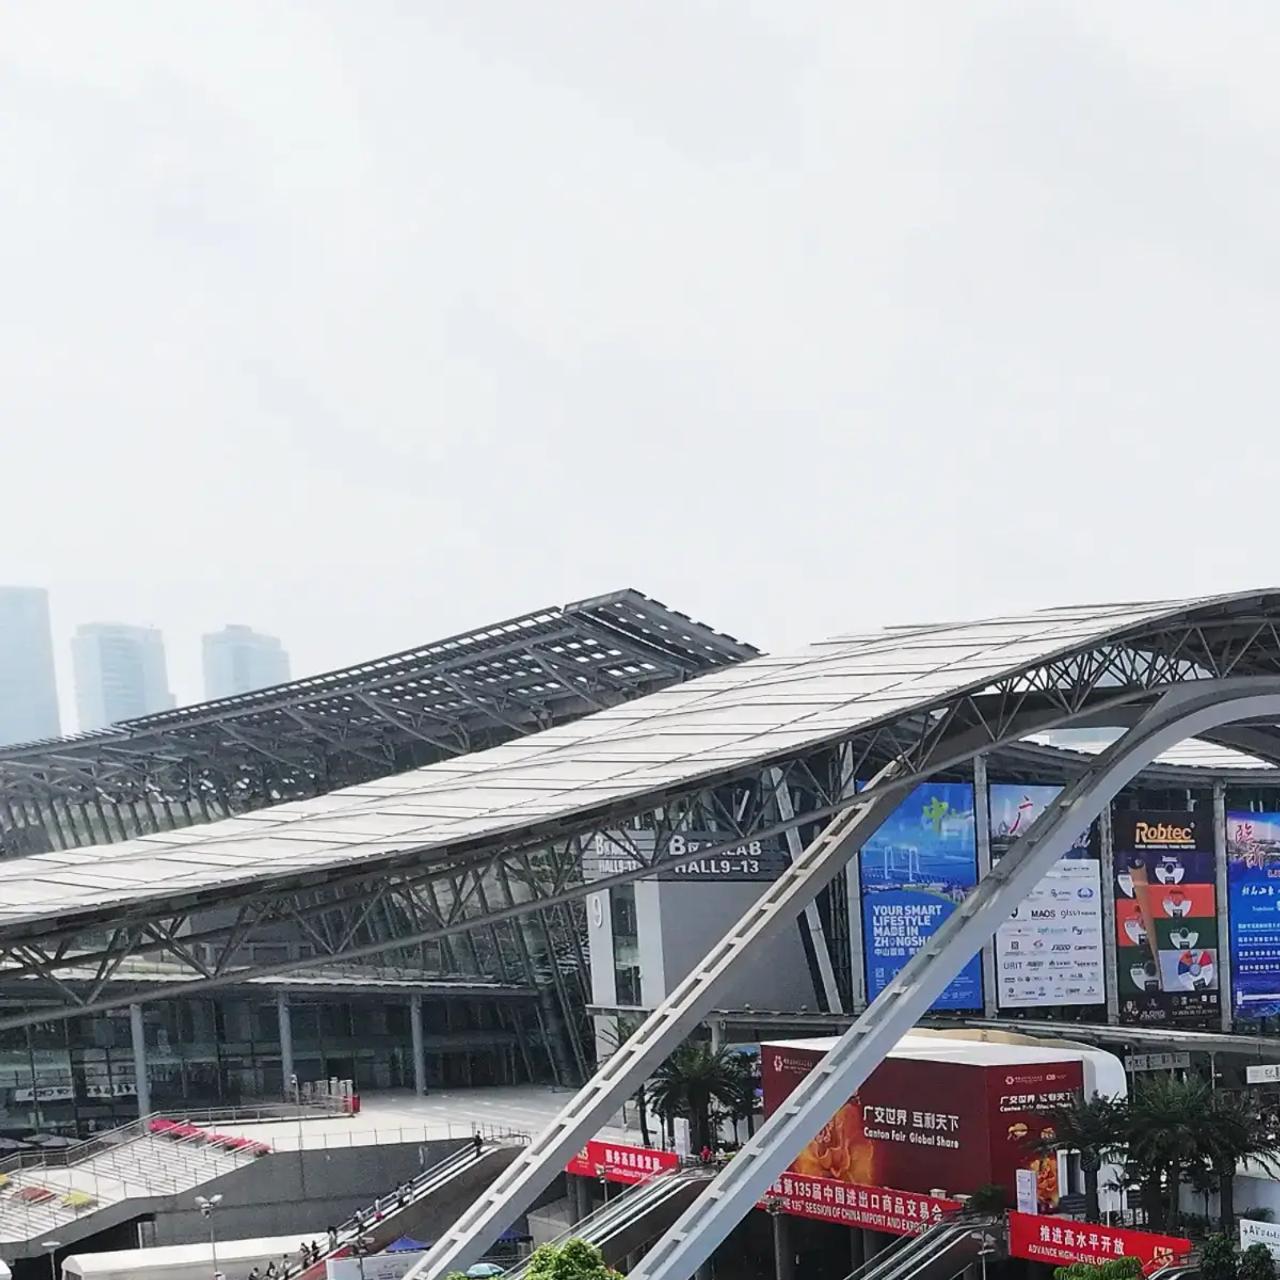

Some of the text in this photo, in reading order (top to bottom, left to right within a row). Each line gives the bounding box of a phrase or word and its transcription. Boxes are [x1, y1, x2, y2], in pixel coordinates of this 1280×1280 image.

[1135, 822, 1193, 843] Robtec
[873, 905, 942, 916] YOUR SMART
[873, 915, 931, 926] LIFESTYLE
[873, 926, 919, 937] MADE IN
[863, 1105, 960, 1132] 广交世界 互利天下
[863, 1126, 959, 1150] Canton Fair Global Share
[805, 1202, 832, 1218] SESSION
[832, 1206, 840, 1218] OF
[841, 1208, 861, 1222] CHINA
[861, 1211, 887, 1227] IMPORT
[1039, 1224, 1125, 1256] 推进高水平开放
[1028, 1243, 1058, 1258] ADVANCE
[1058, 1249, 1097, 1265] HIGH-LEVEL
